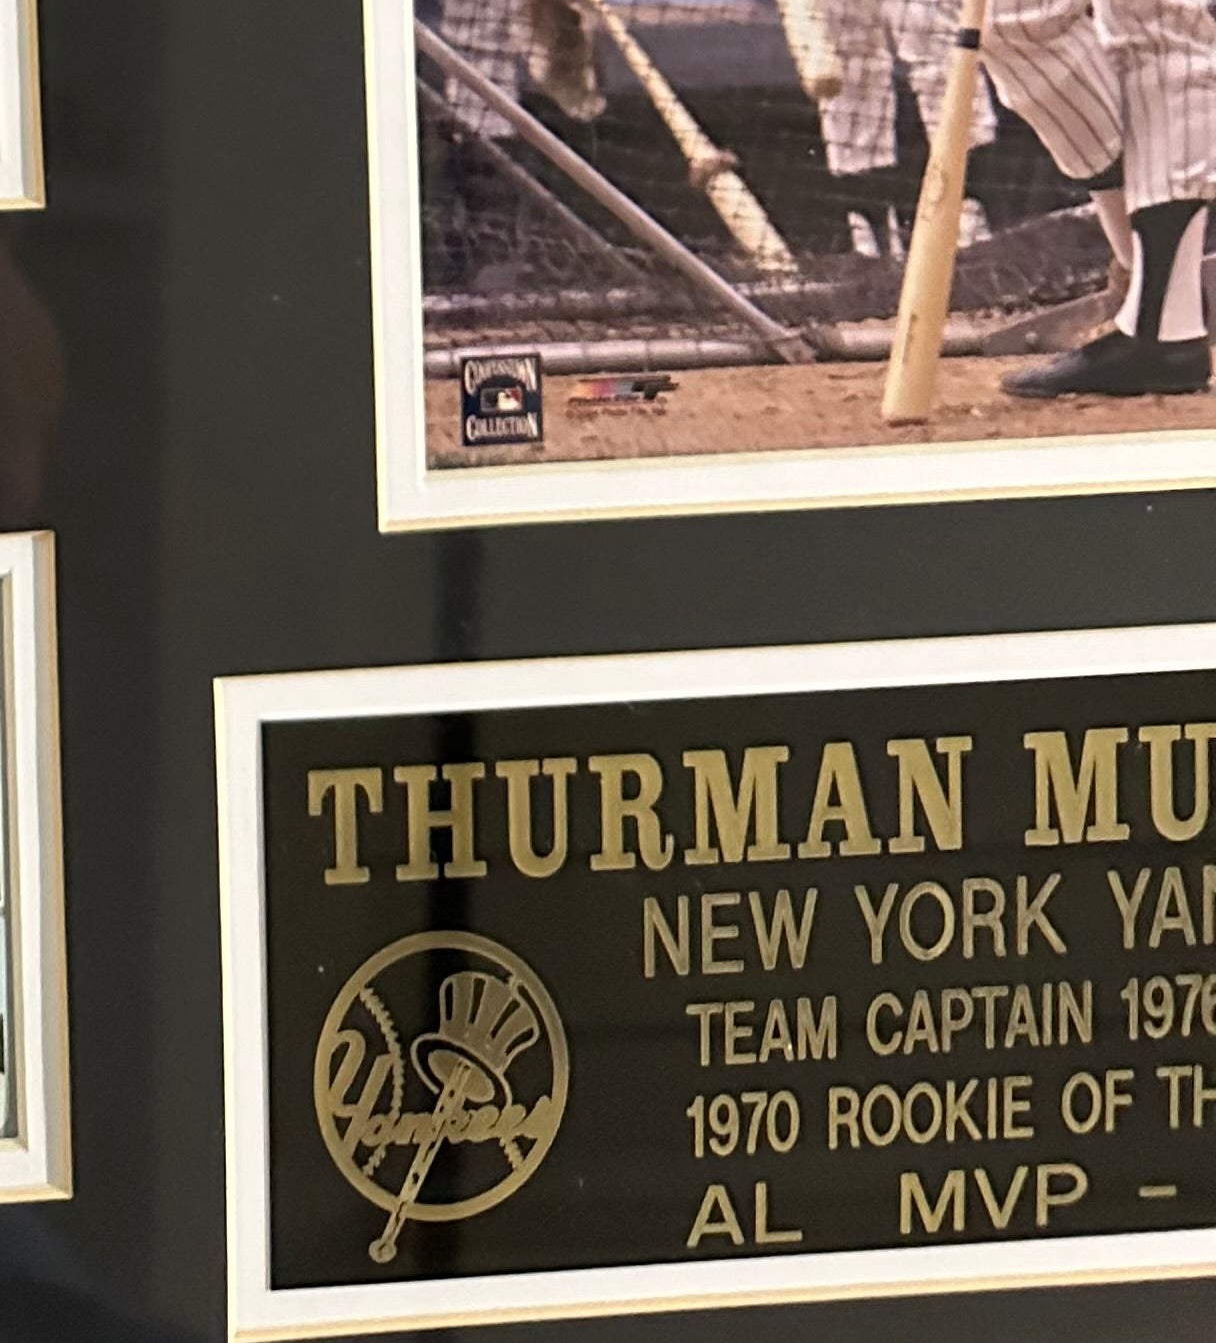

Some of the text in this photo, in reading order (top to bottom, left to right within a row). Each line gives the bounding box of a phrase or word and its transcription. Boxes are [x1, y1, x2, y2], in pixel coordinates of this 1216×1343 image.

[307, 735, 973, 886] THURMAN
[643, 887, 818, 979] NEW
[854, 873, 1067, 965] YORK
[686, 995, 838, 1068] TEAM
[866, 979, 1093, 1056] CAPTAIN
[330, 1029, 552, 1163] Yankees
[686, 1089, 802, 1158] 1970
[828, 1075, 1035, 1150] ROOKIE
[1060, 1068, 1135, 1135] OF
[686, 1181, 803, 1250] AL
[899, 1163, 1089, 1236] MVP
